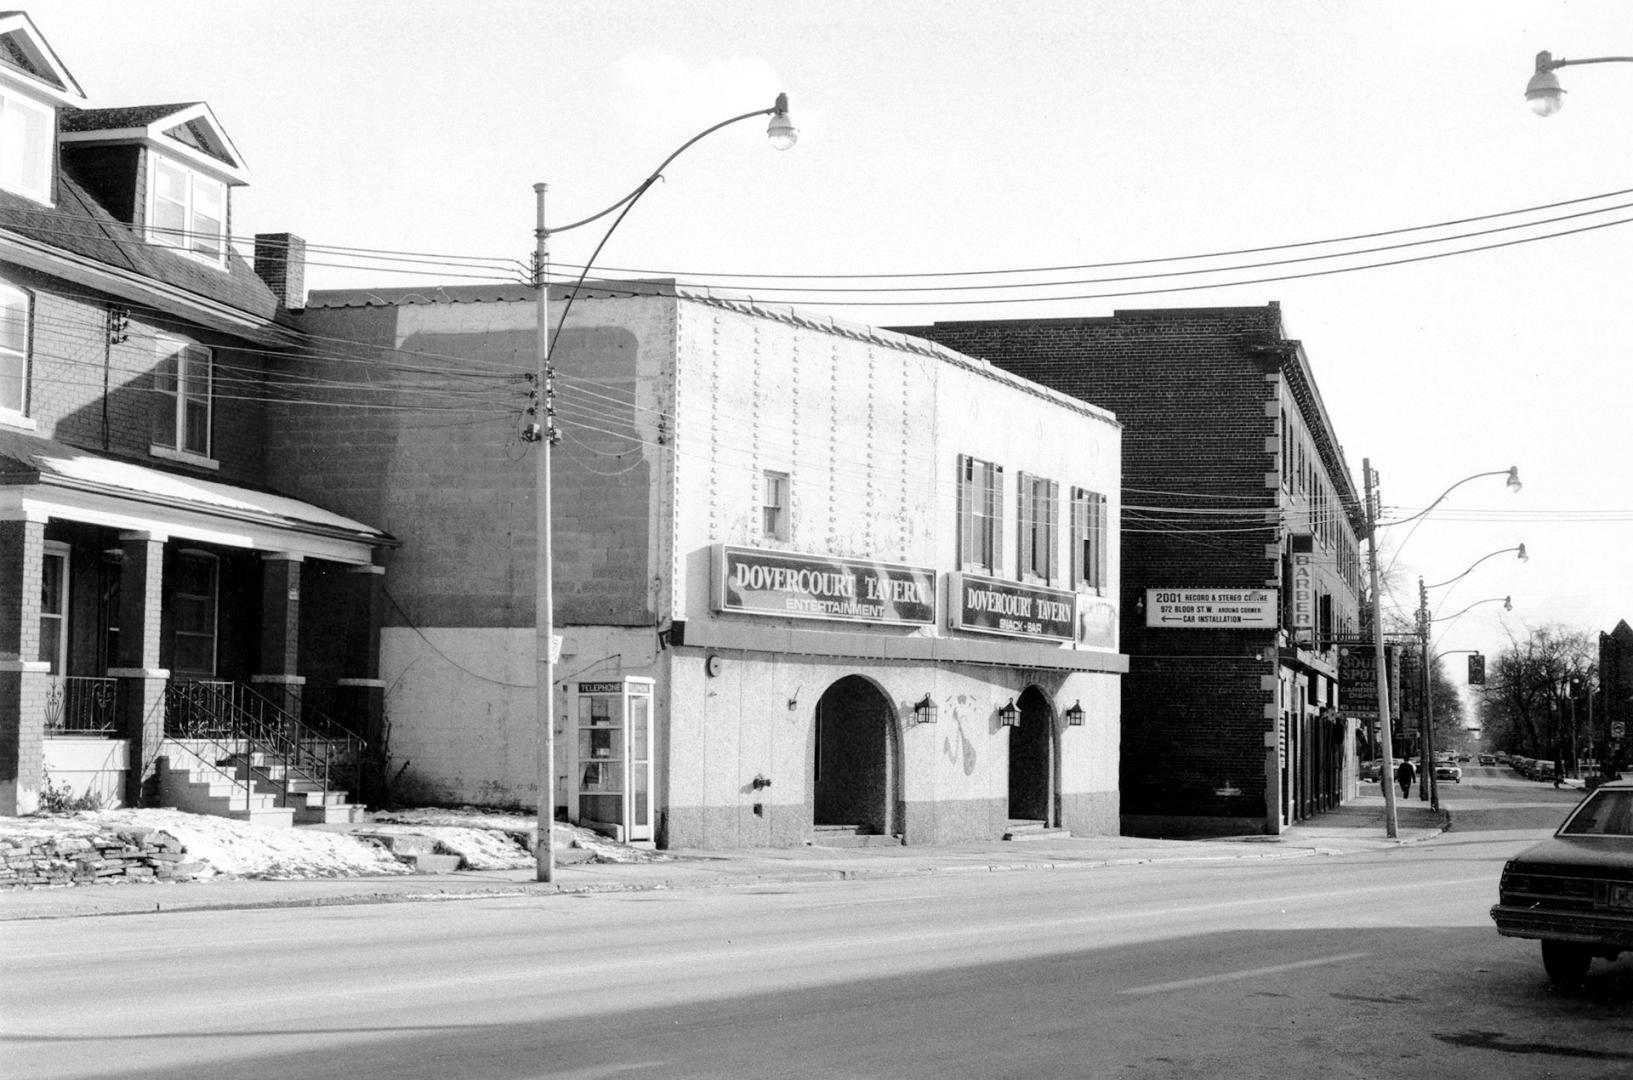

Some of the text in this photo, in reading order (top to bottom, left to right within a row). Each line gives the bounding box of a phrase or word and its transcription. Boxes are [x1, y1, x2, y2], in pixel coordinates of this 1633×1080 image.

[735, 563, 932, 605] DOVERCOURT TAVERN
[1296, 555, 1310, 624] BARBER
[968, 588, 1072, 622] DOVERCOURT TAVERN
[1156, 592, 1181, 603] 2001
[785, 598, 884, 617] ENTERTAINMENT
[1174, 605, 1195, 613] BLOOR
[1198, 615, 1242, 623] INSTALLATION
[581, 684, 621, 692] TELEPHONE
